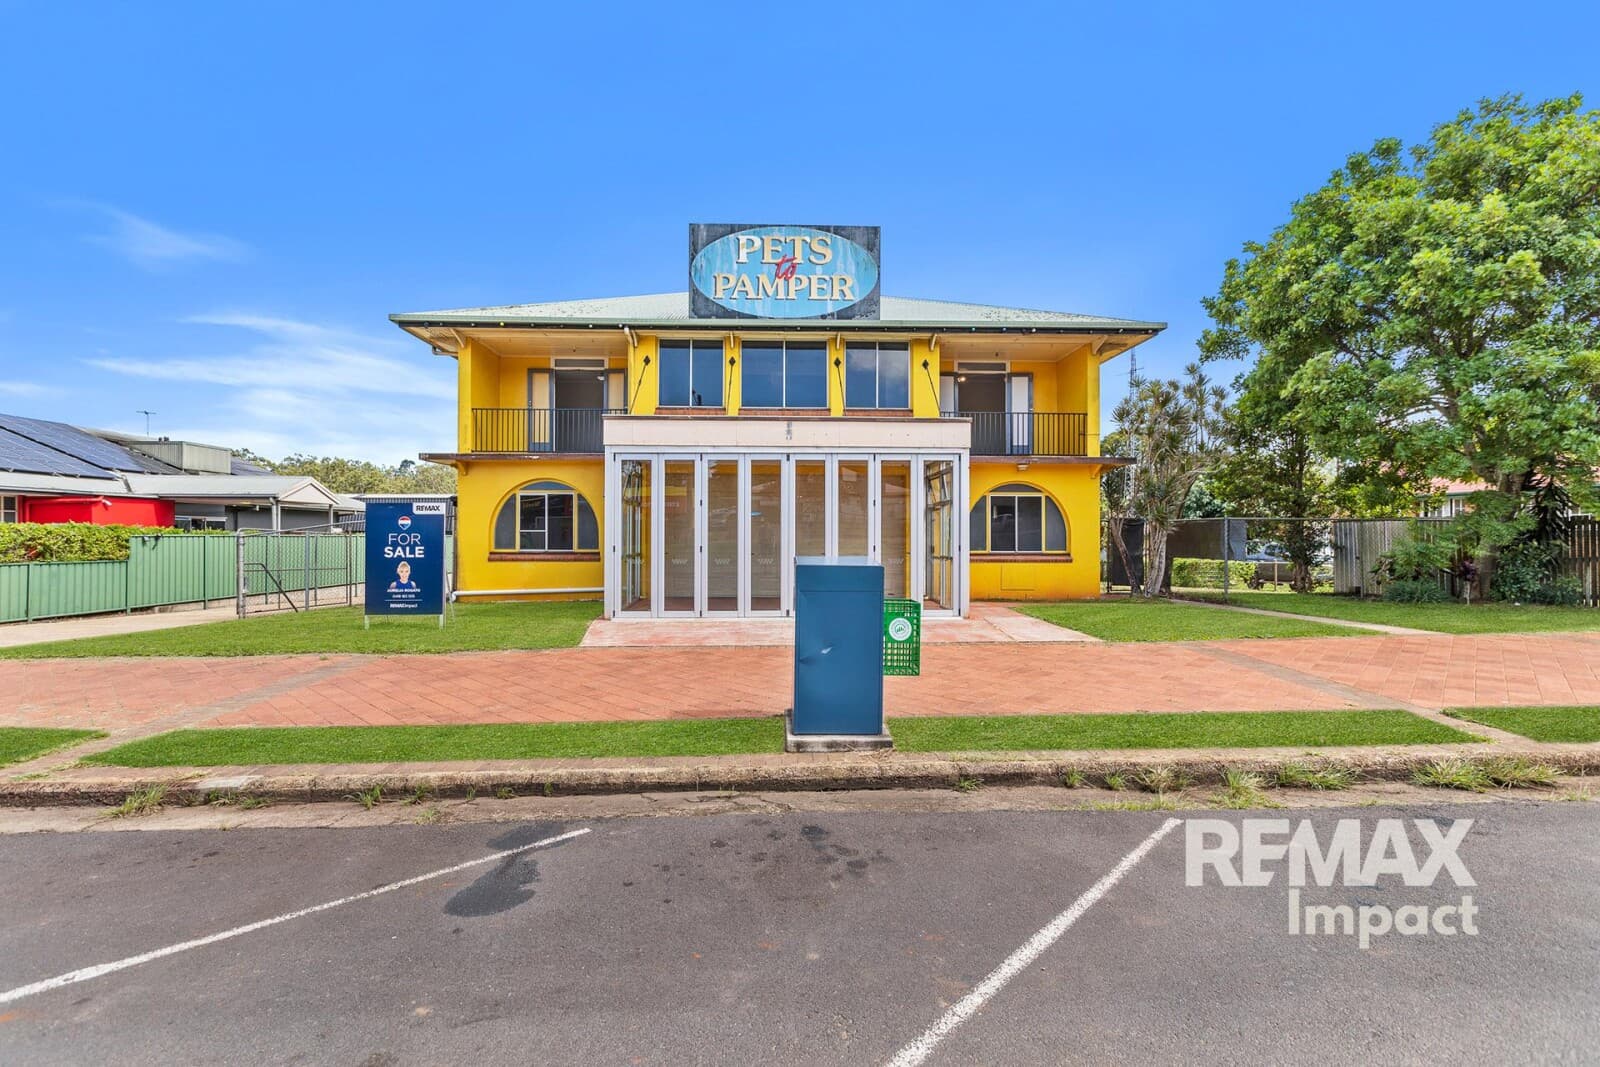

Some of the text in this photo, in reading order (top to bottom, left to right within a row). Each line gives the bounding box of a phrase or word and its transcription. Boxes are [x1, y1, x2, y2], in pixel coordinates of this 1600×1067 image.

[736, 235, 833, 264] PETS
[774, 254, 799, 280] to
[713, 273, 856, 301] PAMPER
[384, 546, 425, 558] SALE
[388, 533, 421, 545] FOR
